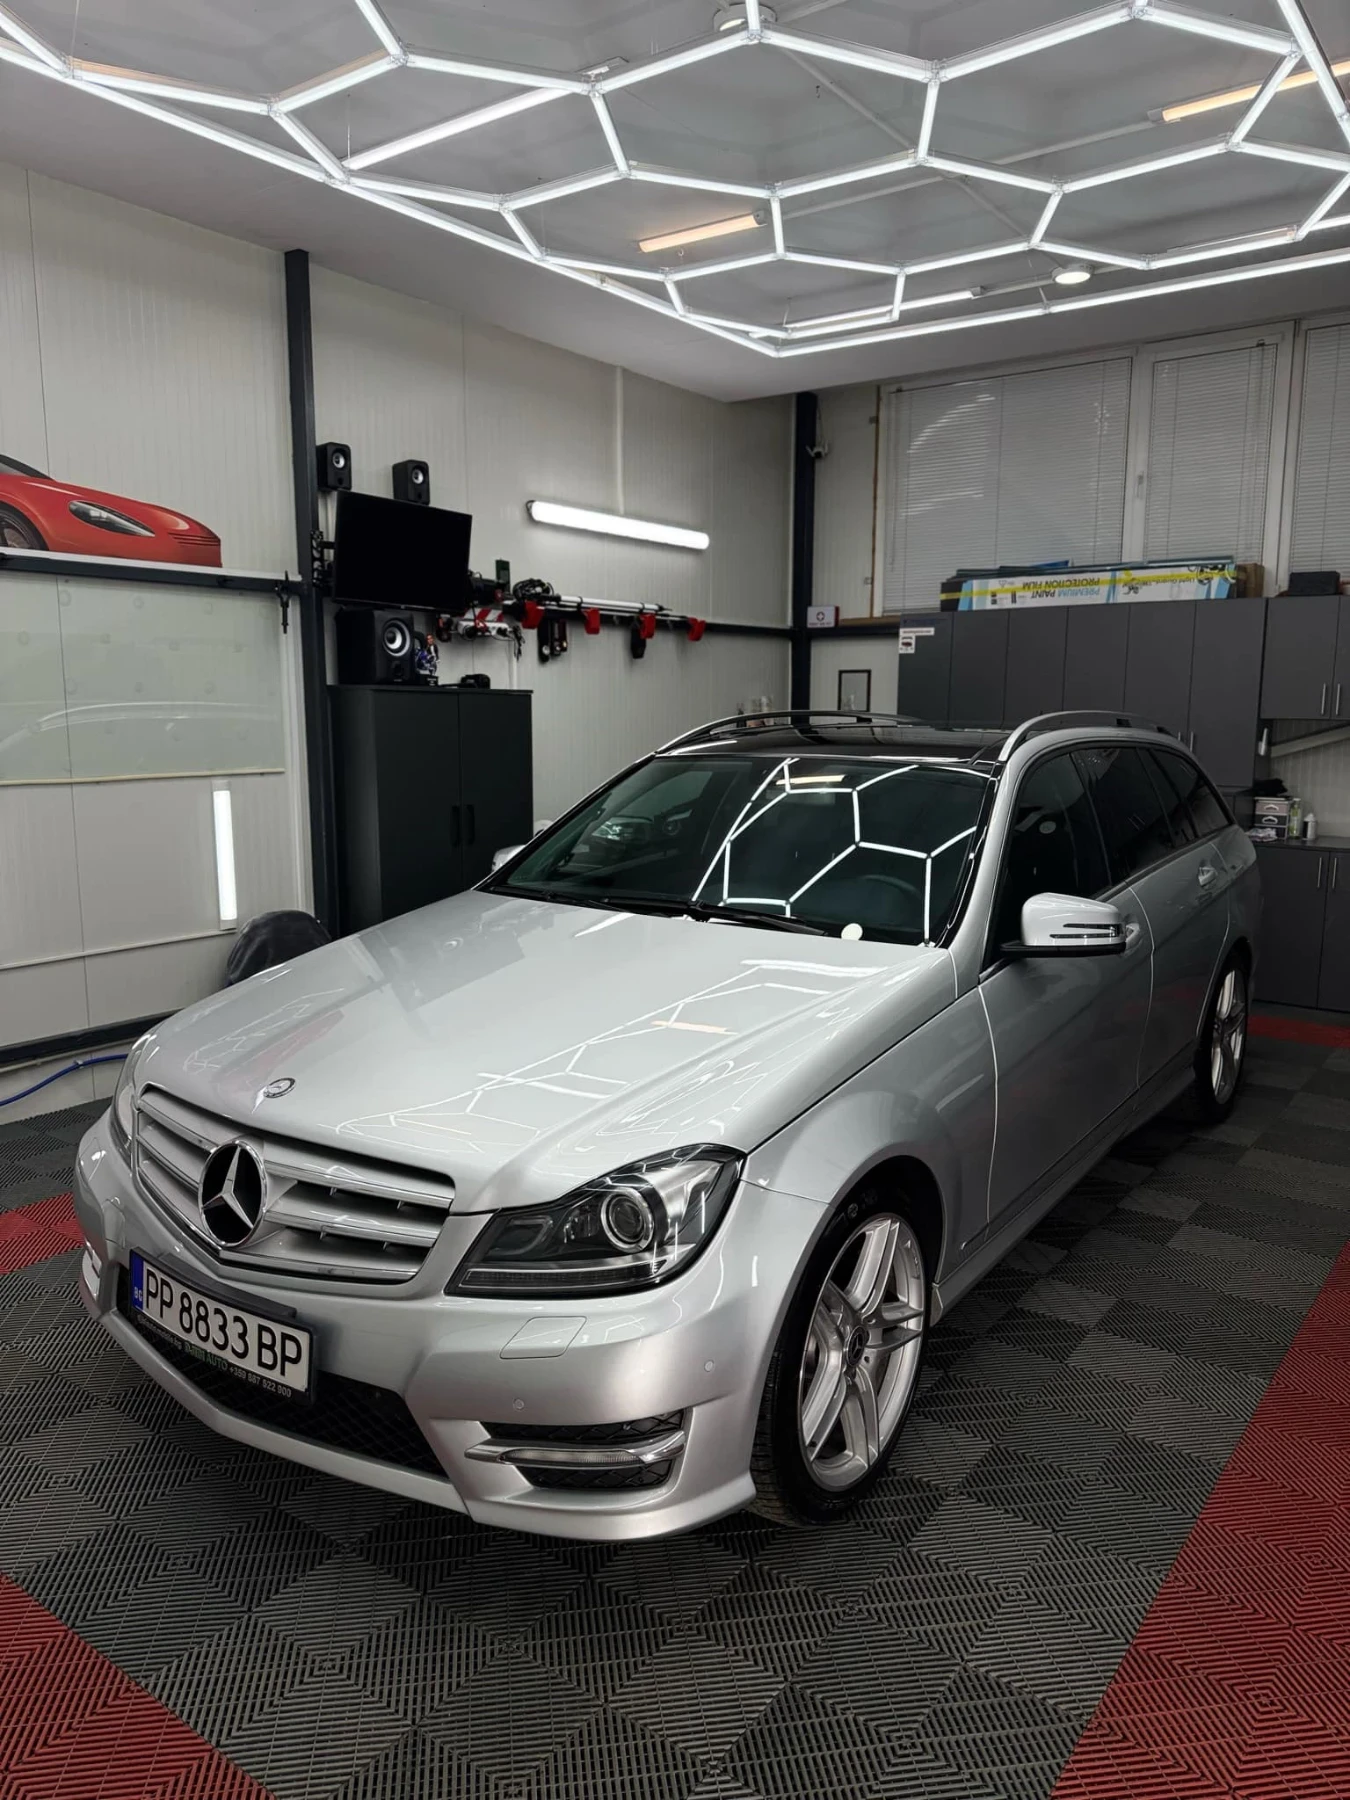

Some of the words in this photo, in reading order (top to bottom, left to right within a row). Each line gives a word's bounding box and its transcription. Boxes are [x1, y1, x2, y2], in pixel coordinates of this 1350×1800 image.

[1022, 580, 1043, 591] FILM
[1044, 578, 1100, 590] PROTECTION
[1030, 589, 1057, 600] PAINT
[1058, 588, 1101, 599] PREMIUM
[146, 1268, 174, 1319] PP
[179, 1291, 250, 1360] 8833
[257, 1323, 302, 1377] BP
[206, 1352, 228, 1372] AUTO
